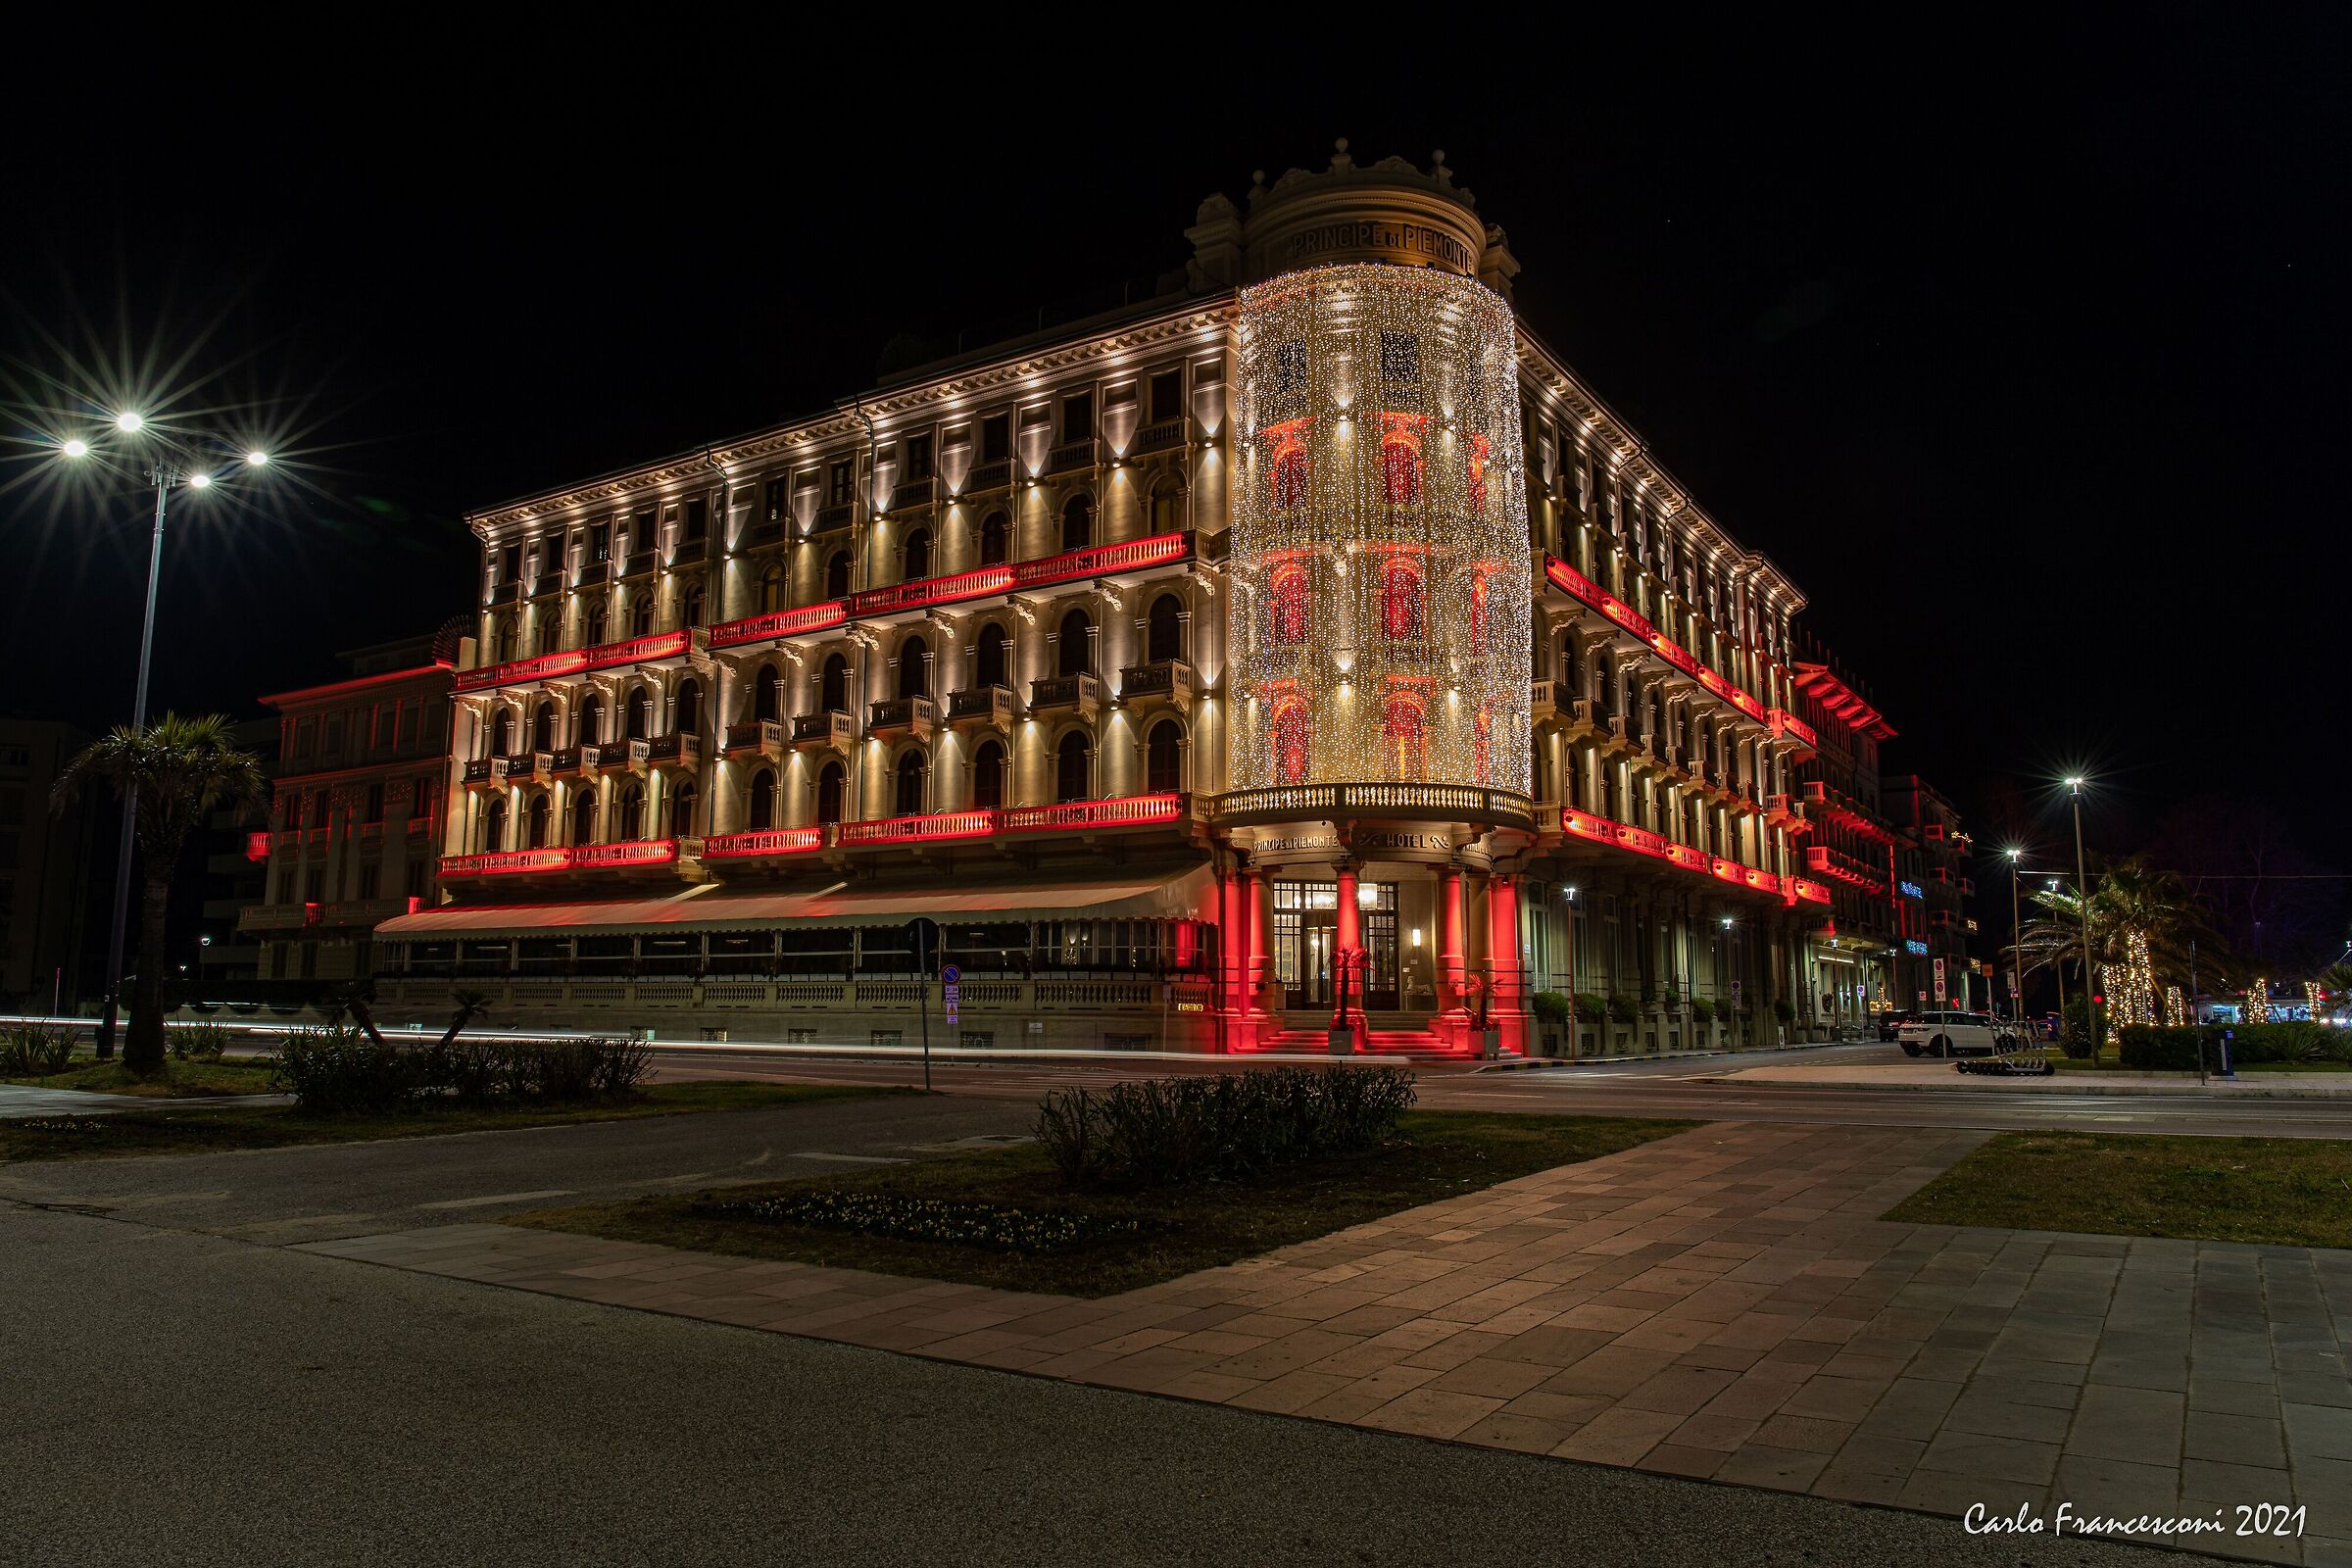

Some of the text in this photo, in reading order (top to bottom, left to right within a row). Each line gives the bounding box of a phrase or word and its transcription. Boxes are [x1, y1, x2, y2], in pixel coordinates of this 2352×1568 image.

[1293, 225, 1384, 257] PRINCIPE
[1404, 226, 1475, 272] PIEMONTE
[1254, 838, 1286, 853] PRINCIPE
[1293, 835, 1339, 849] PIEMONTE
[1387, 833, 1428, 848] HOTEL
